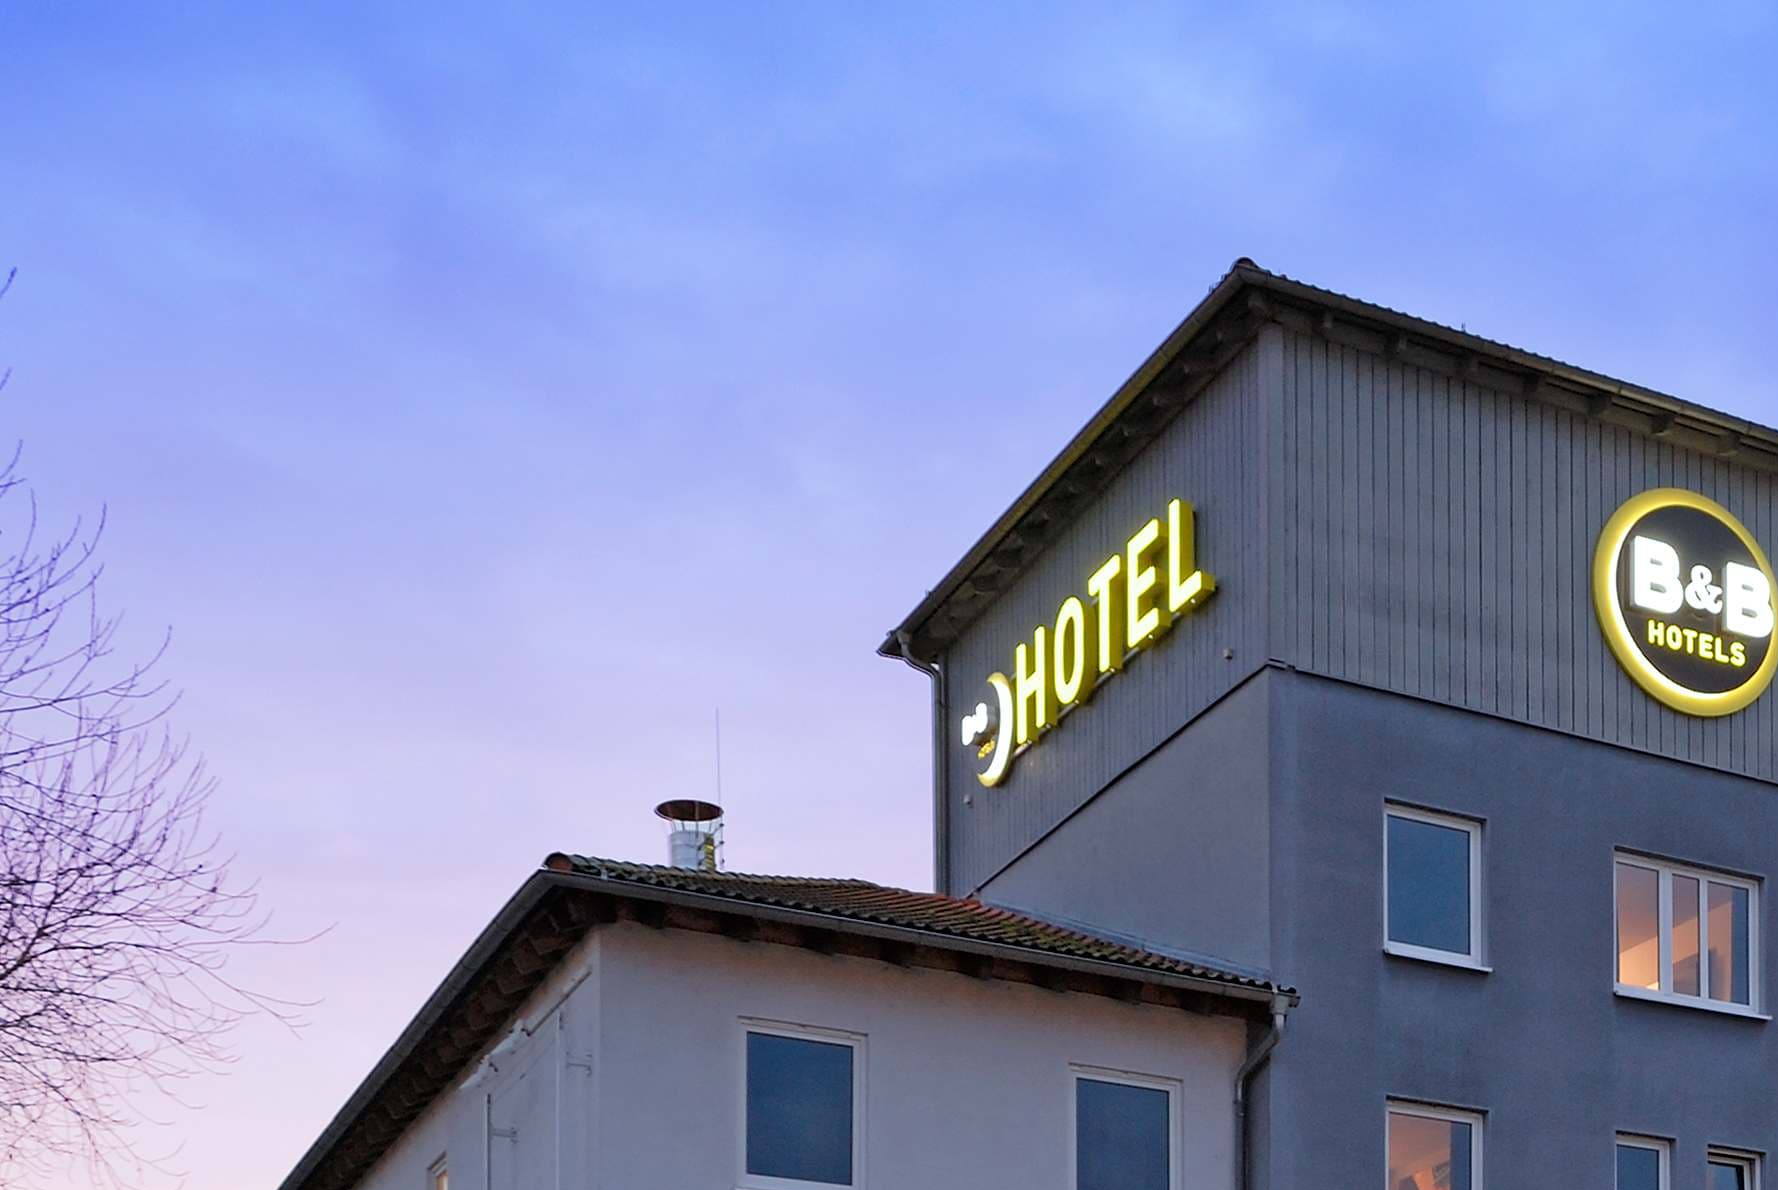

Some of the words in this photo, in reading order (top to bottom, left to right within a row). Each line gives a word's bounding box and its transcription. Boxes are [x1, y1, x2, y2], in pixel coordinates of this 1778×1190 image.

[1015, 497, 1214, 746] HOTEL
[1630, 535, 1774, 638] B&B
[1647, 618, 1746, 668] HOTELS
